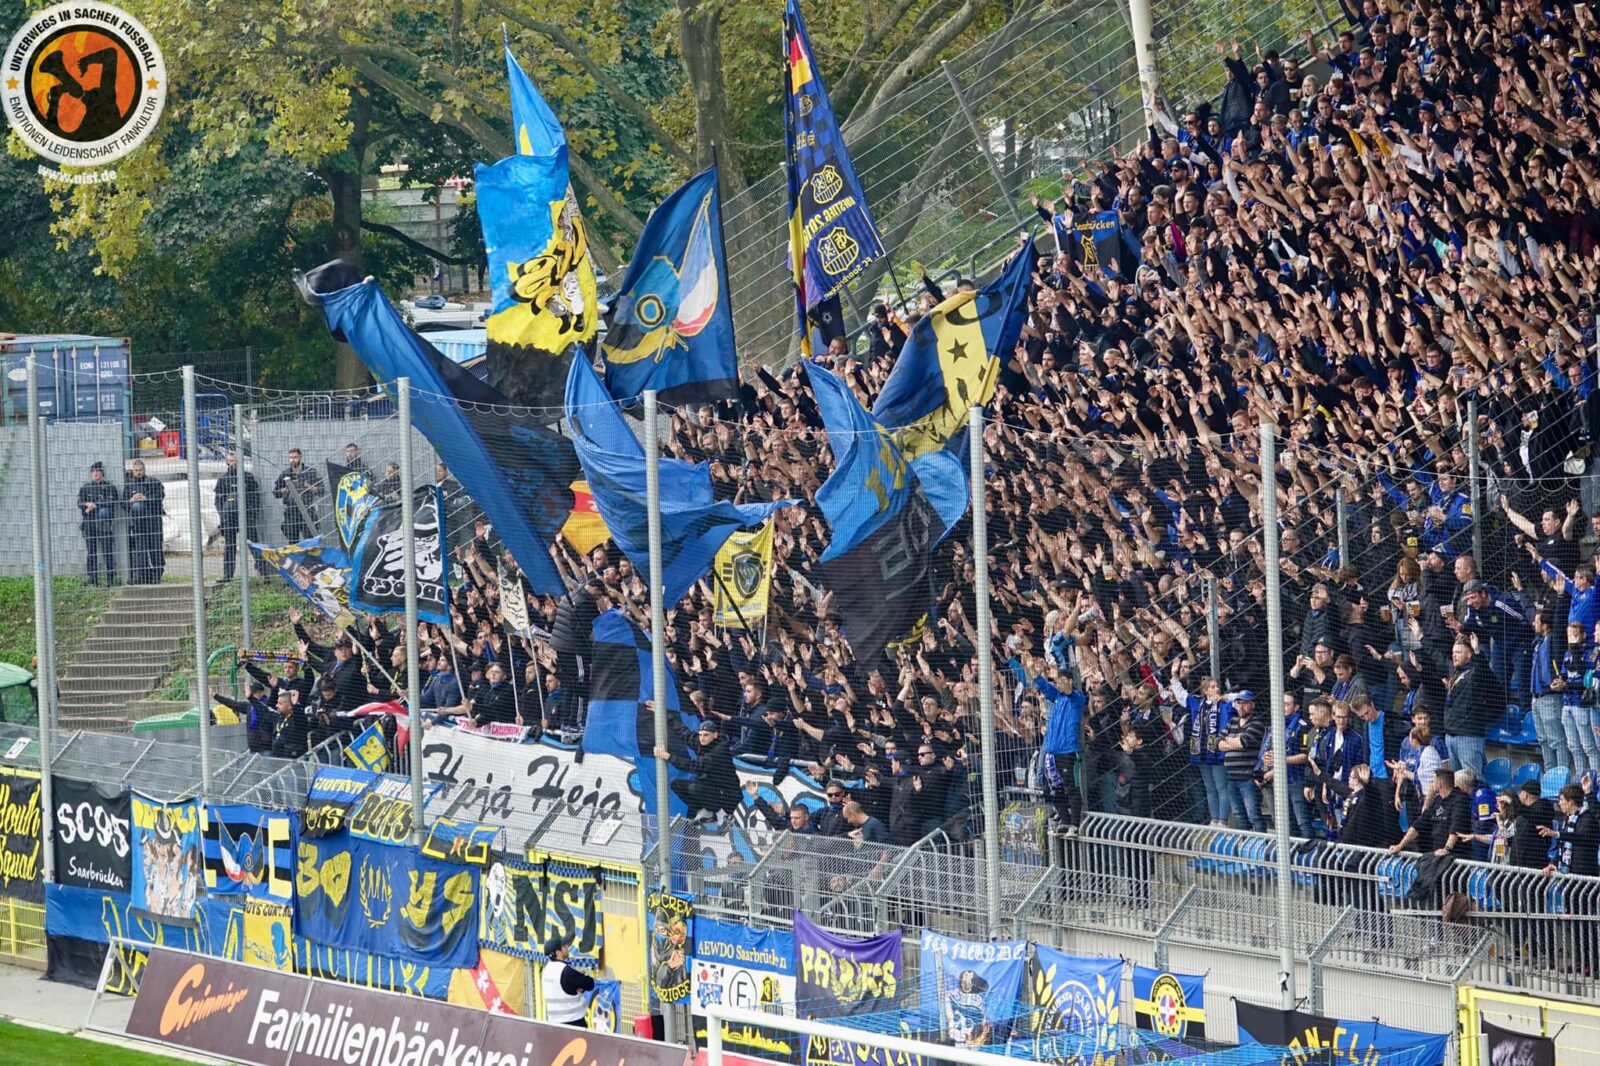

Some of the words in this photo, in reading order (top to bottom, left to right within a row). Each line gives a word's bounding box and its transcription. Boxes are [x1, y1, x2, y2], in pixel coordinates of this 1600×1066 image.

[422, 743, 516, 822] Heja
[527, 755, 626, 846] Heja
[67, 856, 125, 888] Saarbrücken
[697, 940, 735, 960] AEWDO
[160, 963, 248, 1037] Grimminger
